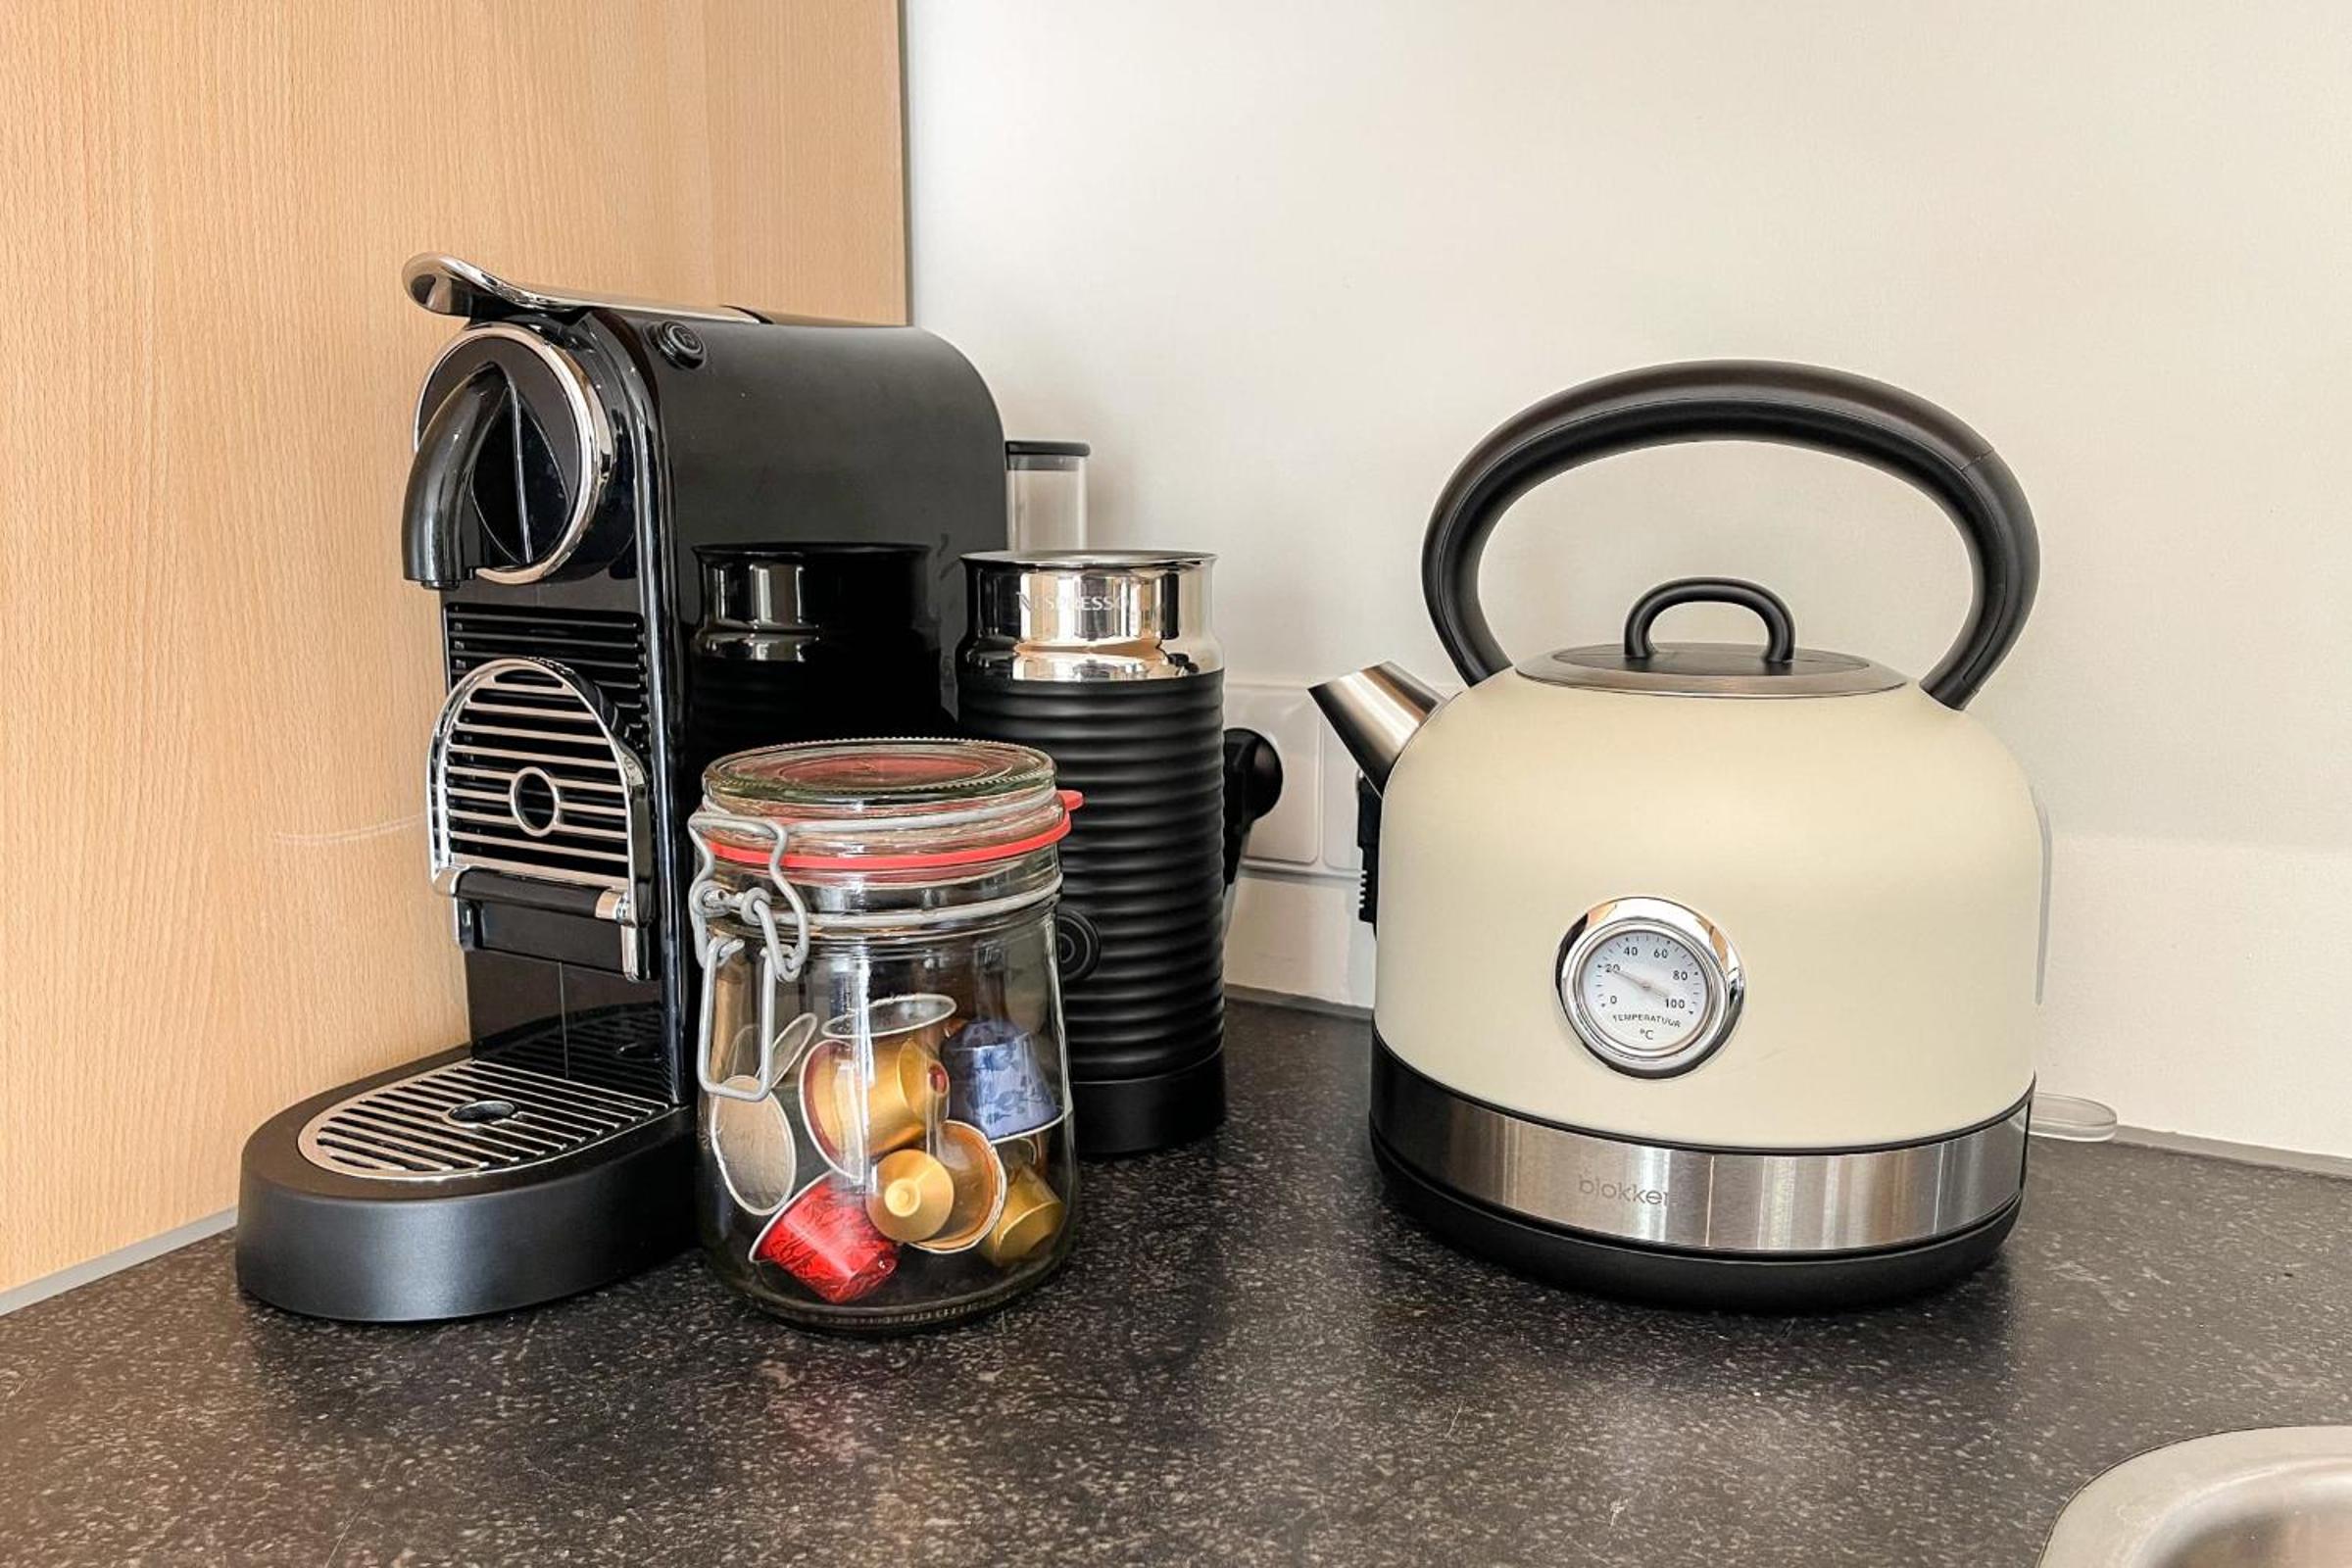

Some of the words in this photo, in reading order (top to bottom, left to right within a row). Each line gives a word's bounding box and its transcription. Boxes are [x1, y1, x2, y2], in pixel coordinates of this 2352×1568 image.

[1623, 947, 1639, 956] 40
[1653, 949, 1668, 958] 60
[1605, 963, 1620, 973] 20
[1673, 970, 1688, 981] 80
[1610, 995, 1617, 1004] 0
[1665, 999, 1685, 1009] 100
[1612, 1013, 1681, 1027] TEMPERATUUR
